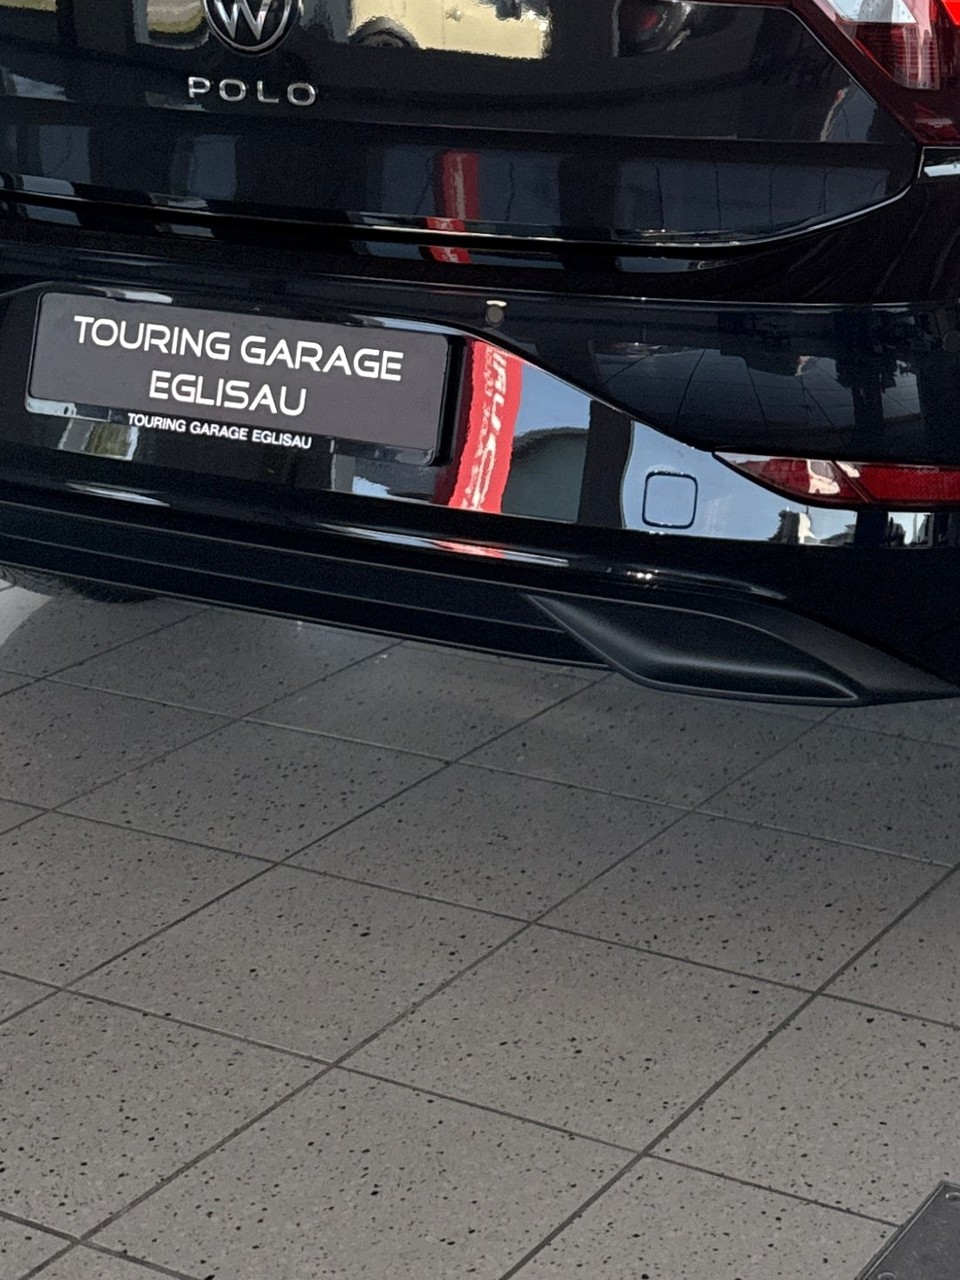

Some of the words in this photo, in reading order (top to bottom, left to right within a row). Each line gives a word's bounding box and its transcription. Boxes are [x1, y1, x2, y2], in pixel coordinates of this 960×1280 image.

[187, 76, 317, 106] POLO
[73, 315, 231, 361] TOURING
[240, 335, 405, 381] GARAGE
[148, 370, 307, 416] EGLISAU
[127, 412, 187, 433] TOURING
[189, 420, 249, 441] GARAGE
[251, 428, 313, 449] EGLISAU
